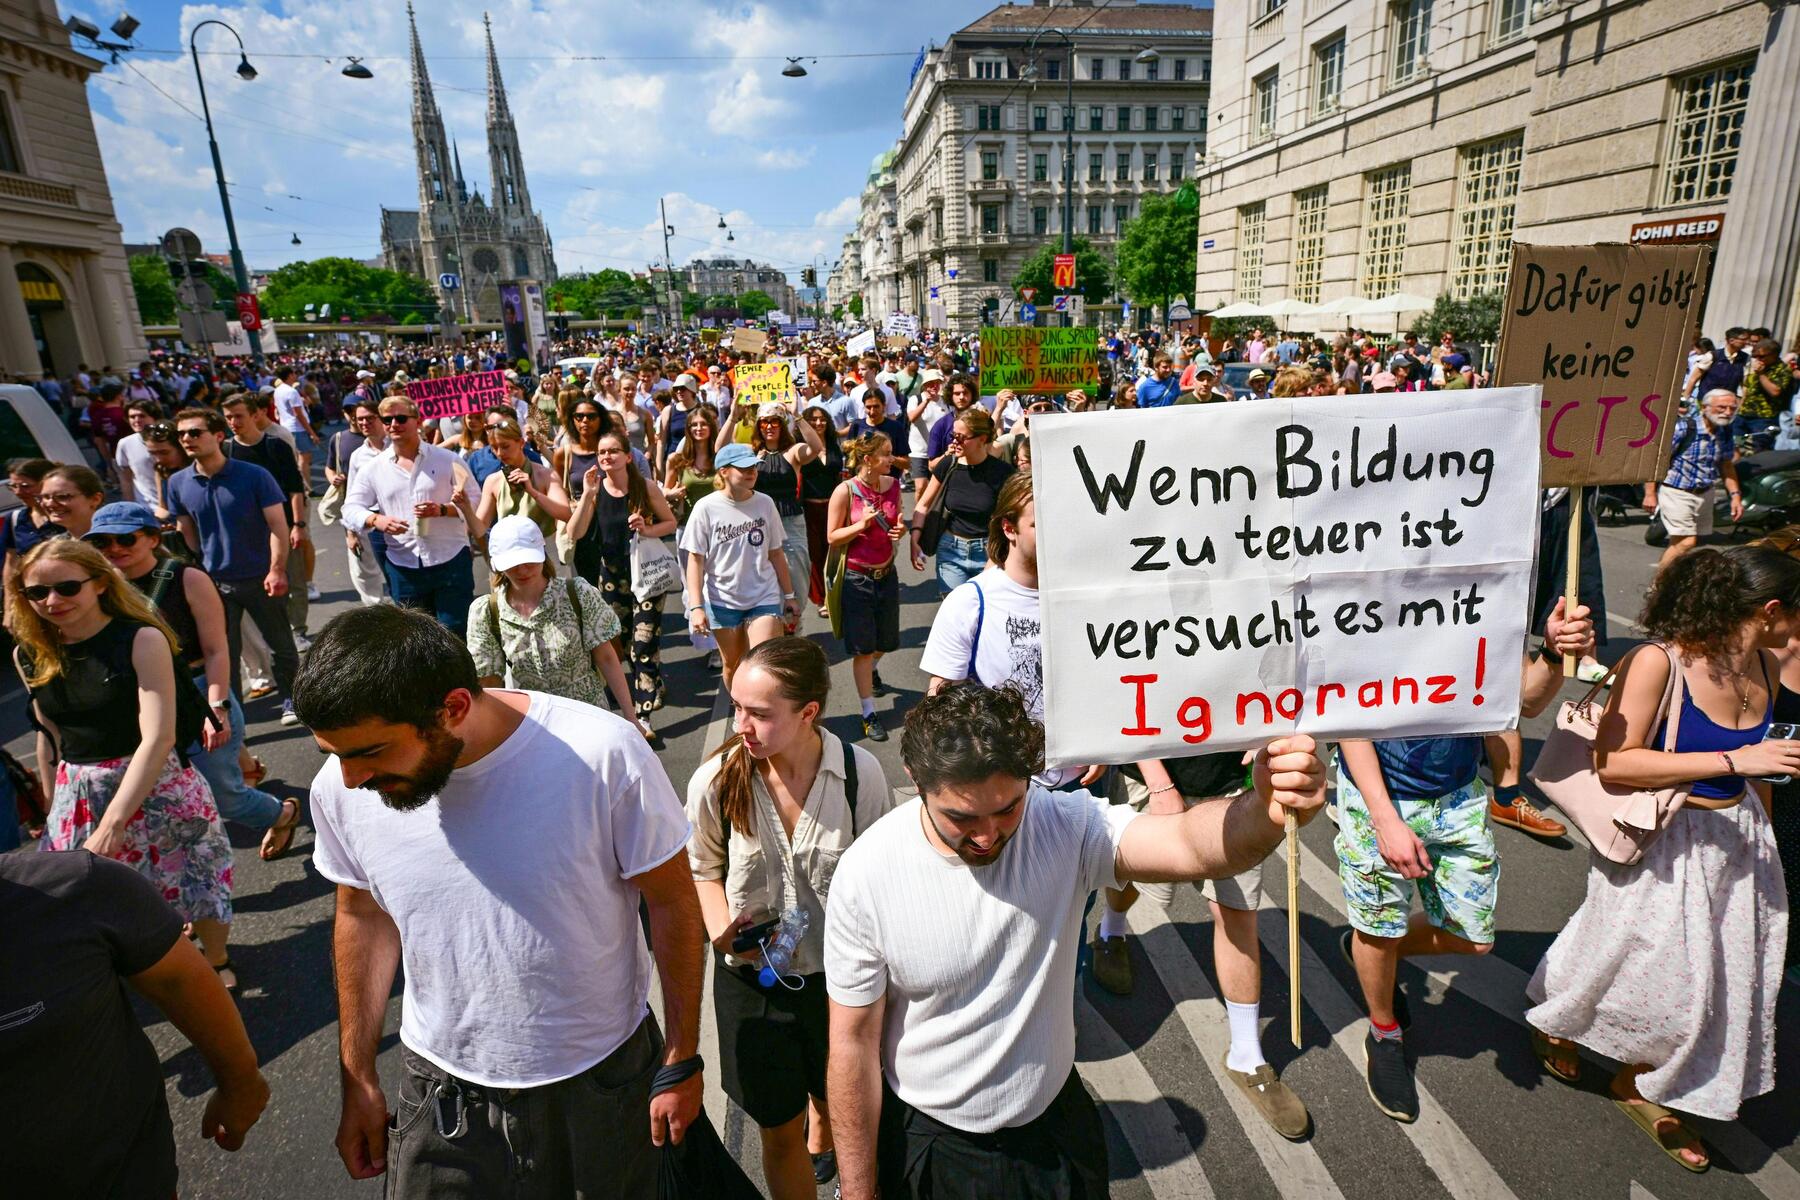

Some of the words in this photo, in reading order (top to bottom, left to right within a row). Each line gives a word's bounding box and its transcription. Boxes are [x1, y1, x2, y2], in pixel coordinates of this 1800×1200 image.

[1631, 225, 1674, 241] JOHN
[1675, 220, 1720, 236] REED
[1515, 263, 1621, 317] Dafür
[1001, 329, 1024, 347] DER
[1024, 329, 1064, 348] BILDUNG
[735, 364, 762, 377] FEWER
[983, 348, 1033, 367] UNSERE
[1039, 347, 1083, 365] ZUKUNFT
[1542, 342, 1635, 381] keine
[981, 369, 999, 386] DIE
[1002, 368, 1035, 385] WAND
[1040, 367, 1094, 386] FAHREN?
[467, 390, 505, 411] MEHR
[1540, 394, 1661, 459] CTS
[1072, 439, 1257, 516] Wenn
[1275, 423, 1495, 508] Bildung
[1129, 535, 1216, 572] zu
[1234, 514, 1383, 562] teuer
[1400, 508, 1465, 550] ist
[1086, 593, 1322, 660] versucht
[1333, 600, 1385, 636] es
[1397, 582, 1486, 627] mit
